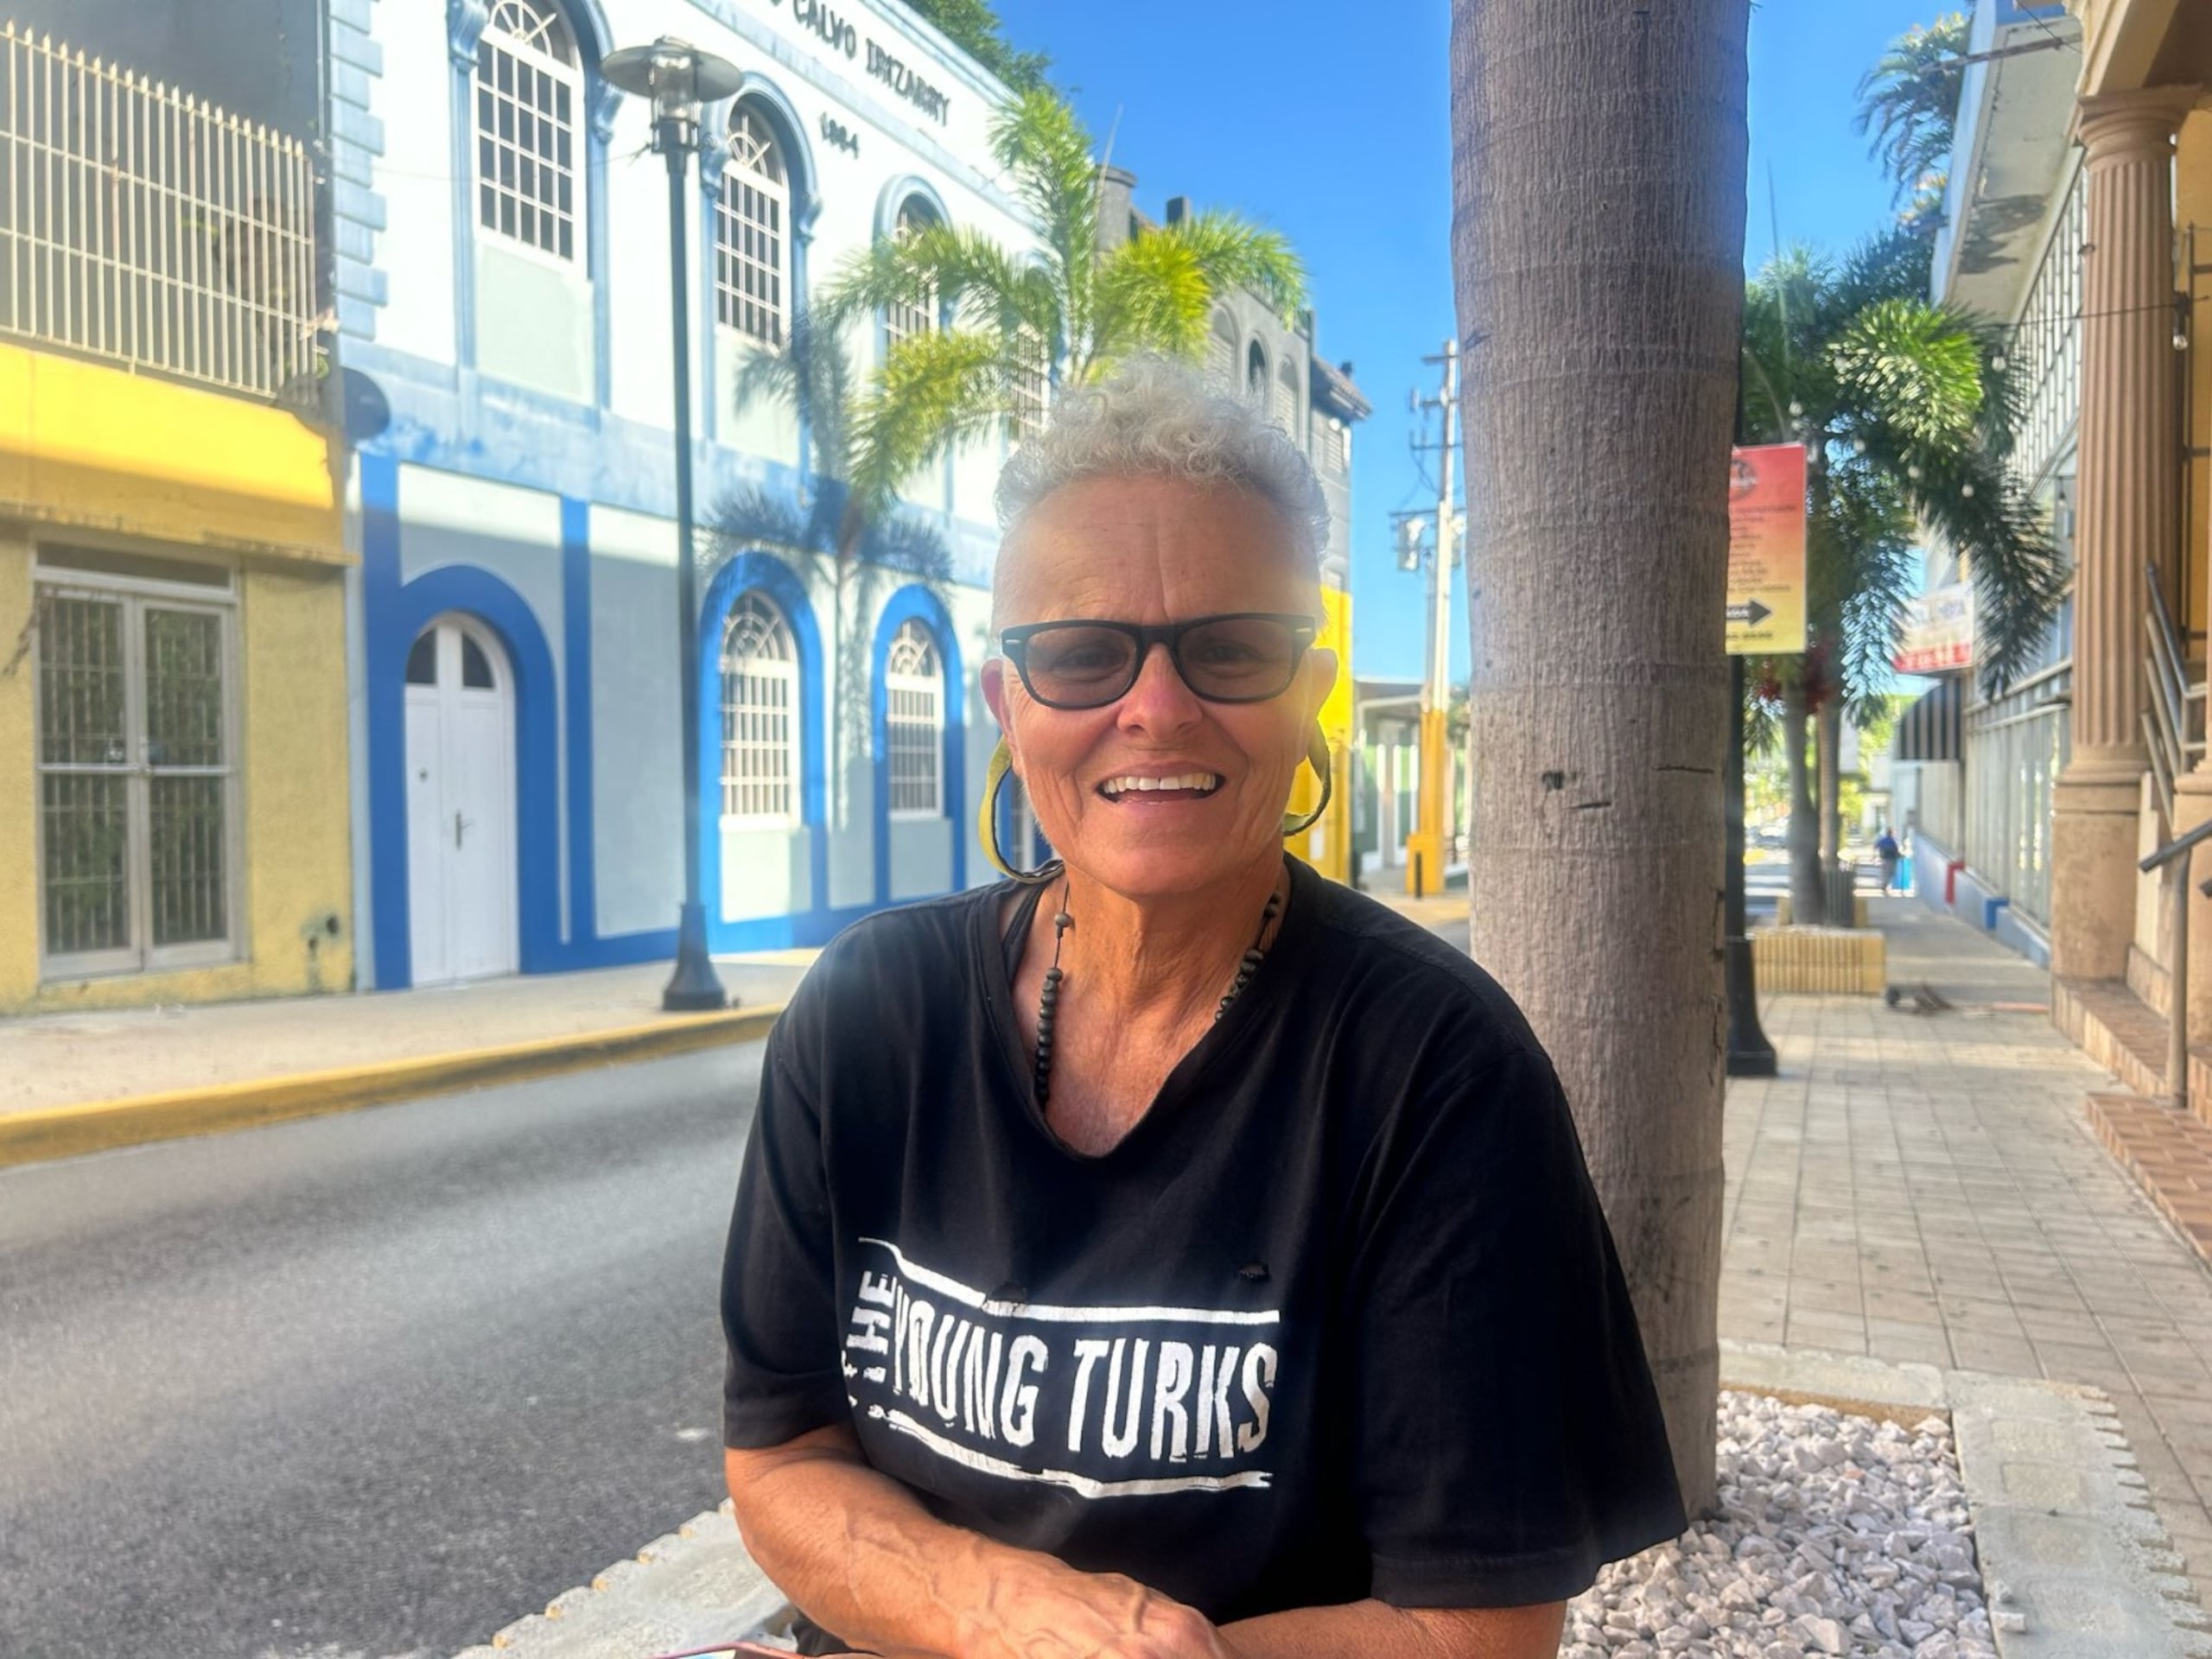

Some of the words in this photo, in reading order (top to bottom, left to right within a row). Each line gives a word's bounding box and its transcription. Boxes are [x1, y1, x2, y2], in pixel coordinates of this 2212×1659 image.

[793, 0, 856, 60] CALVO
[893, 1283, 1049, 1447] YOUNG
[1068, 1338, 1278, 1464] TURKS
